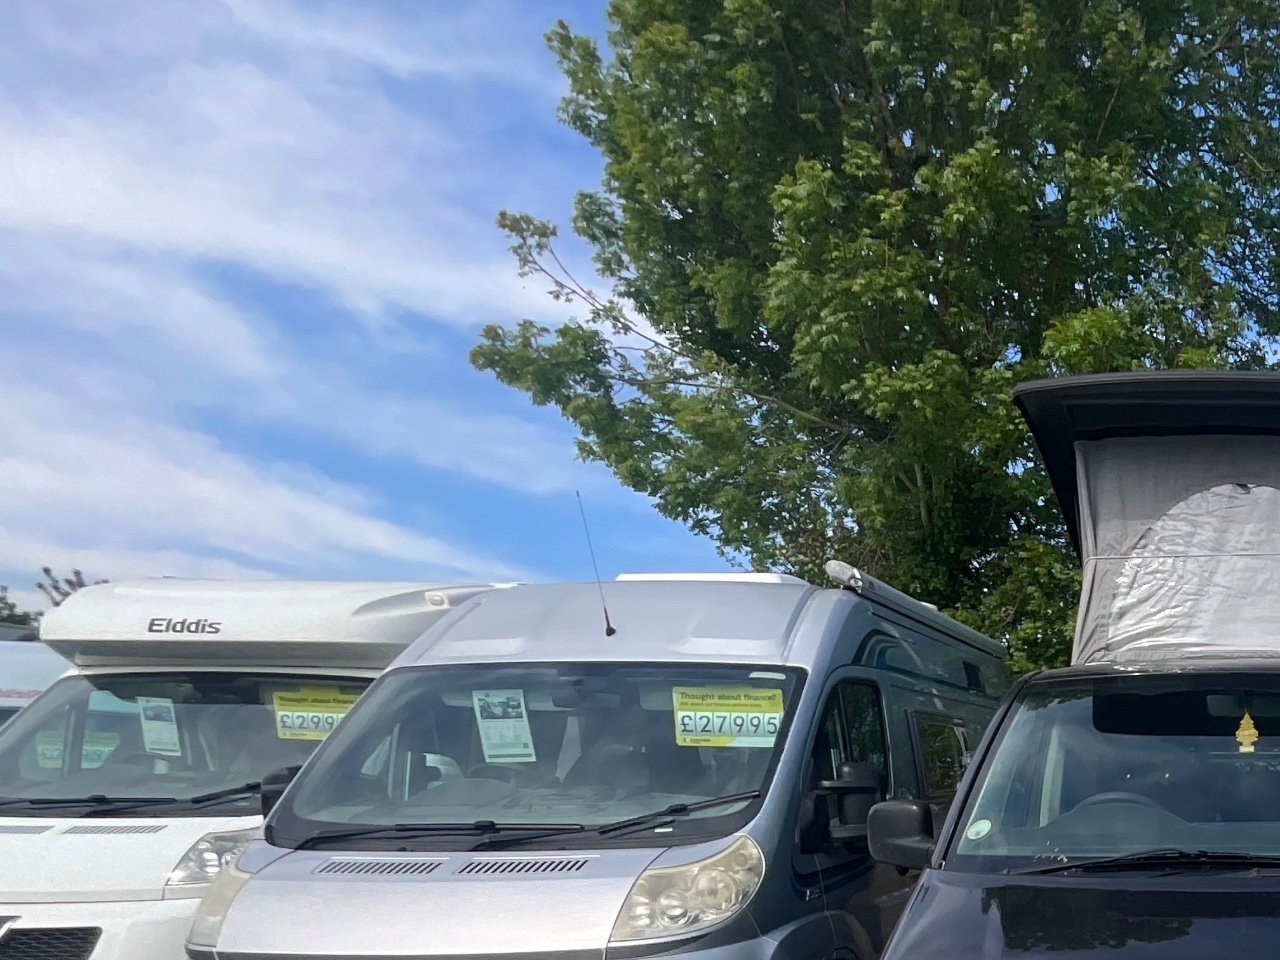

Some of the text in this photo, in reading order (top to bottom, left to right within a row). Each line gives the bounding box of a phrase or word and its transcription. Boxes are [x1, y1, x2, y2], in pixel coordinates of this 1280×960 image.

[148, 618, 222, 634] Elddis
[680, 692, 776, 702] Thought about finance?
[281, 713, 338, 731] £299
[680, 714, 778, 735] £27995
